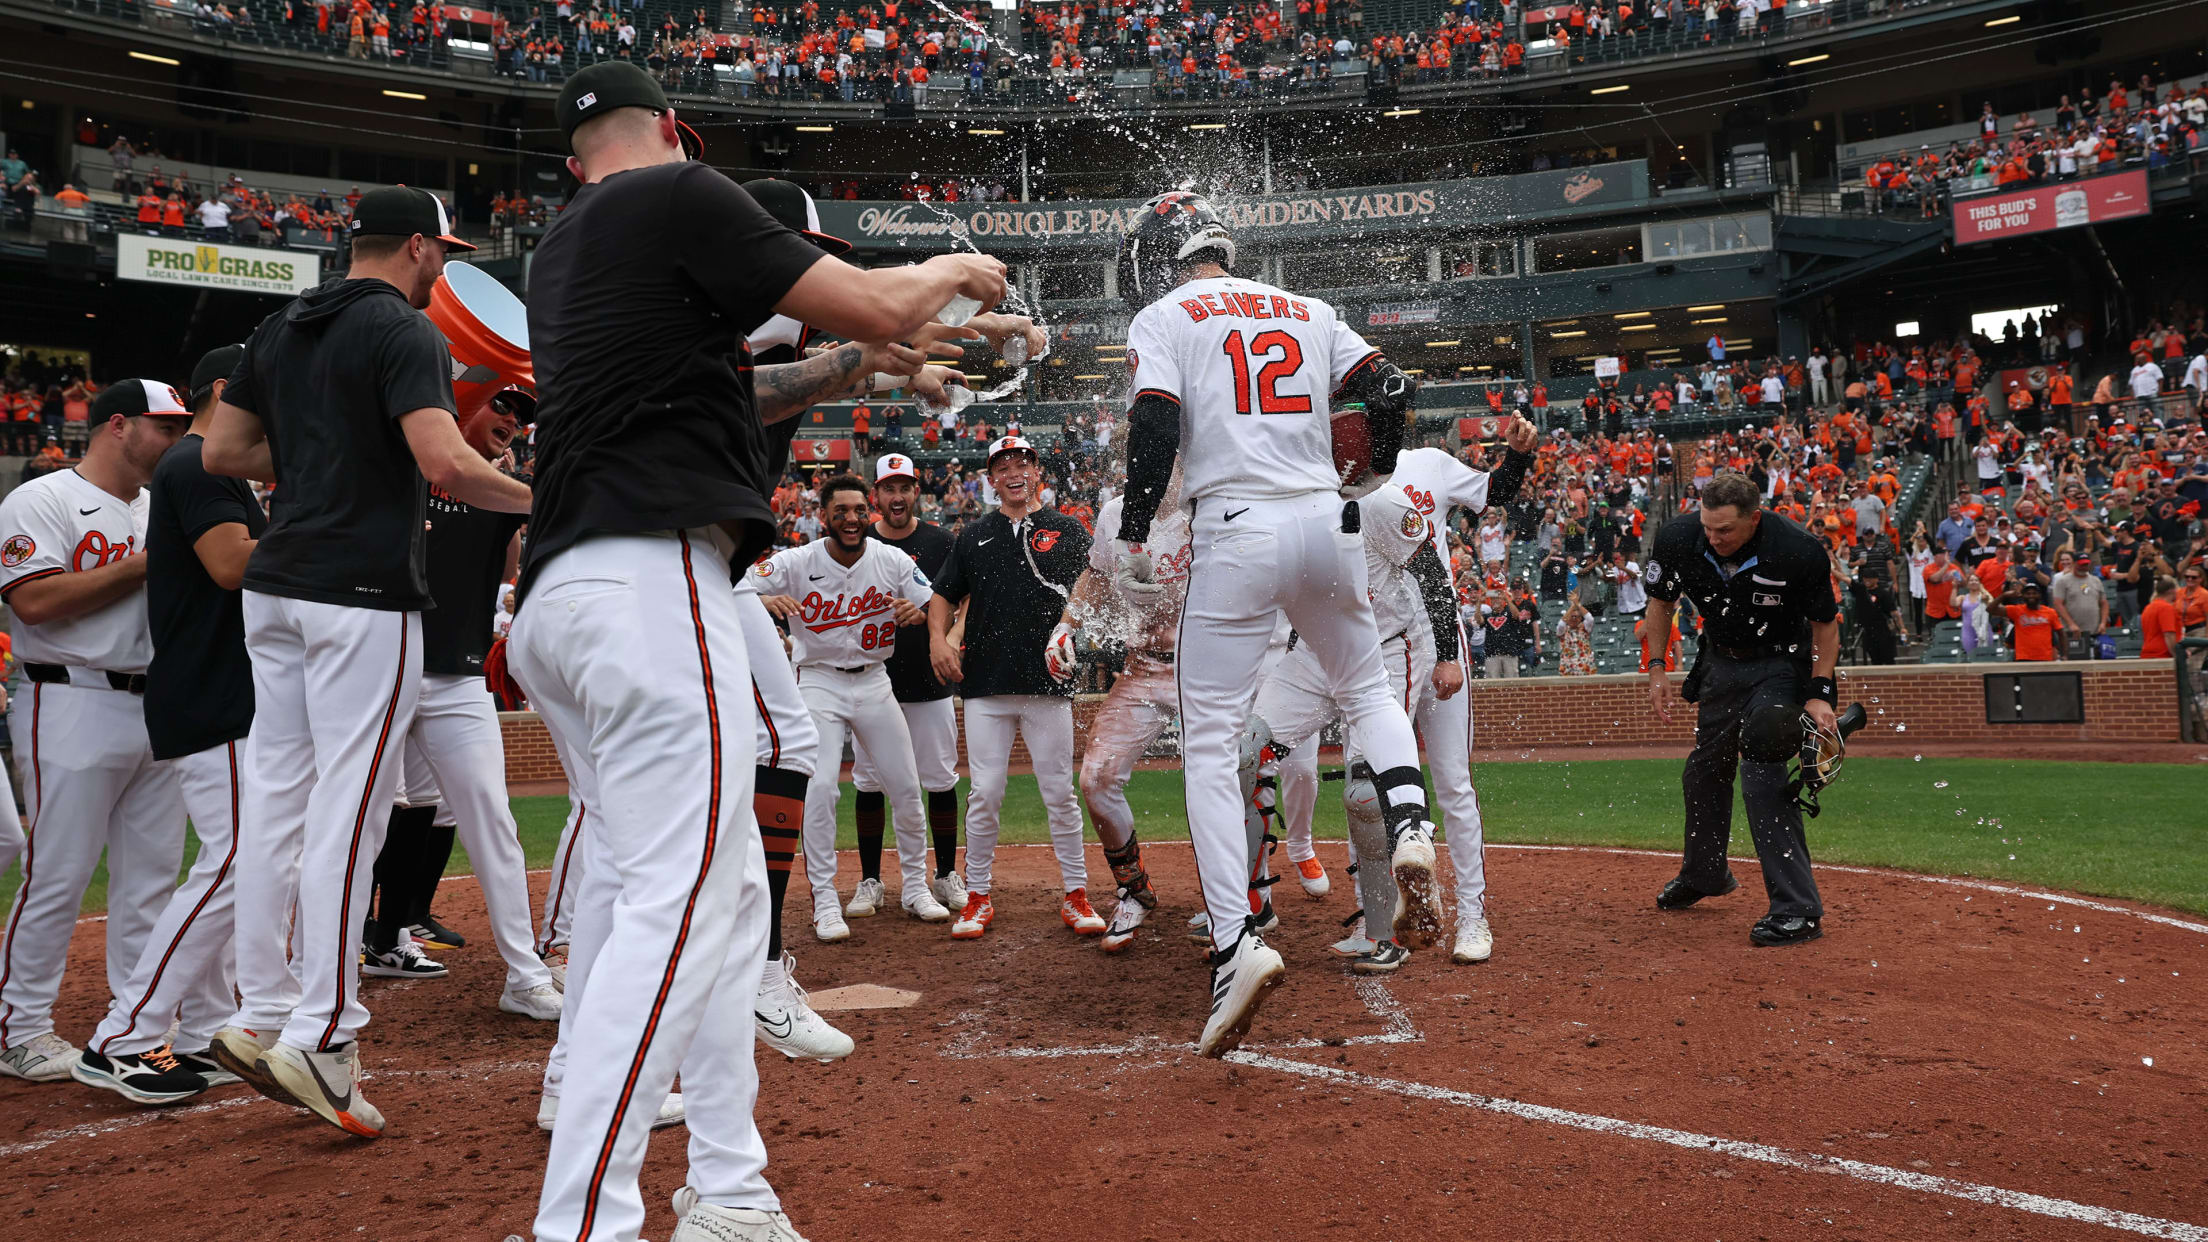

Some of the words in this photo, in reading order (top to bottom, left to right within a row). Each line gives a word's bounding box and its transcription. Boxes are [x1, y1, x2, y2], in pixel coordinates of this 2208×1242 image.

[858, 205, 950, 237] Welcome
[970, 208, 1084, 236] ORIOLE
[1223, 197, 1333, 229] AMDEN
[1335, 189, 1436, 221] YARDS
[1968, 205, 1998, 220] THIS
[1999, 198, 2037, 214] BUD'S
[1977, 217, 2002, 232] FOR
[2004, 213, 2030, 228] YOU
[146, 270, 179, 280] LOCAL
[181, 273, 209, 283] LAWN
[212, 276, 239, 286] CARE
[241, 279, 269, 289] SINCE
[147, 248, 195, 271] PRO
[219, 257, 294, 281] GRASS
[1178, 292, 1311, 323] BEAVERS
[1223, 329, 1312, 415] 12
[429, 499, 468, 513] SEBAL
[861, 621, 896, 651] 82
